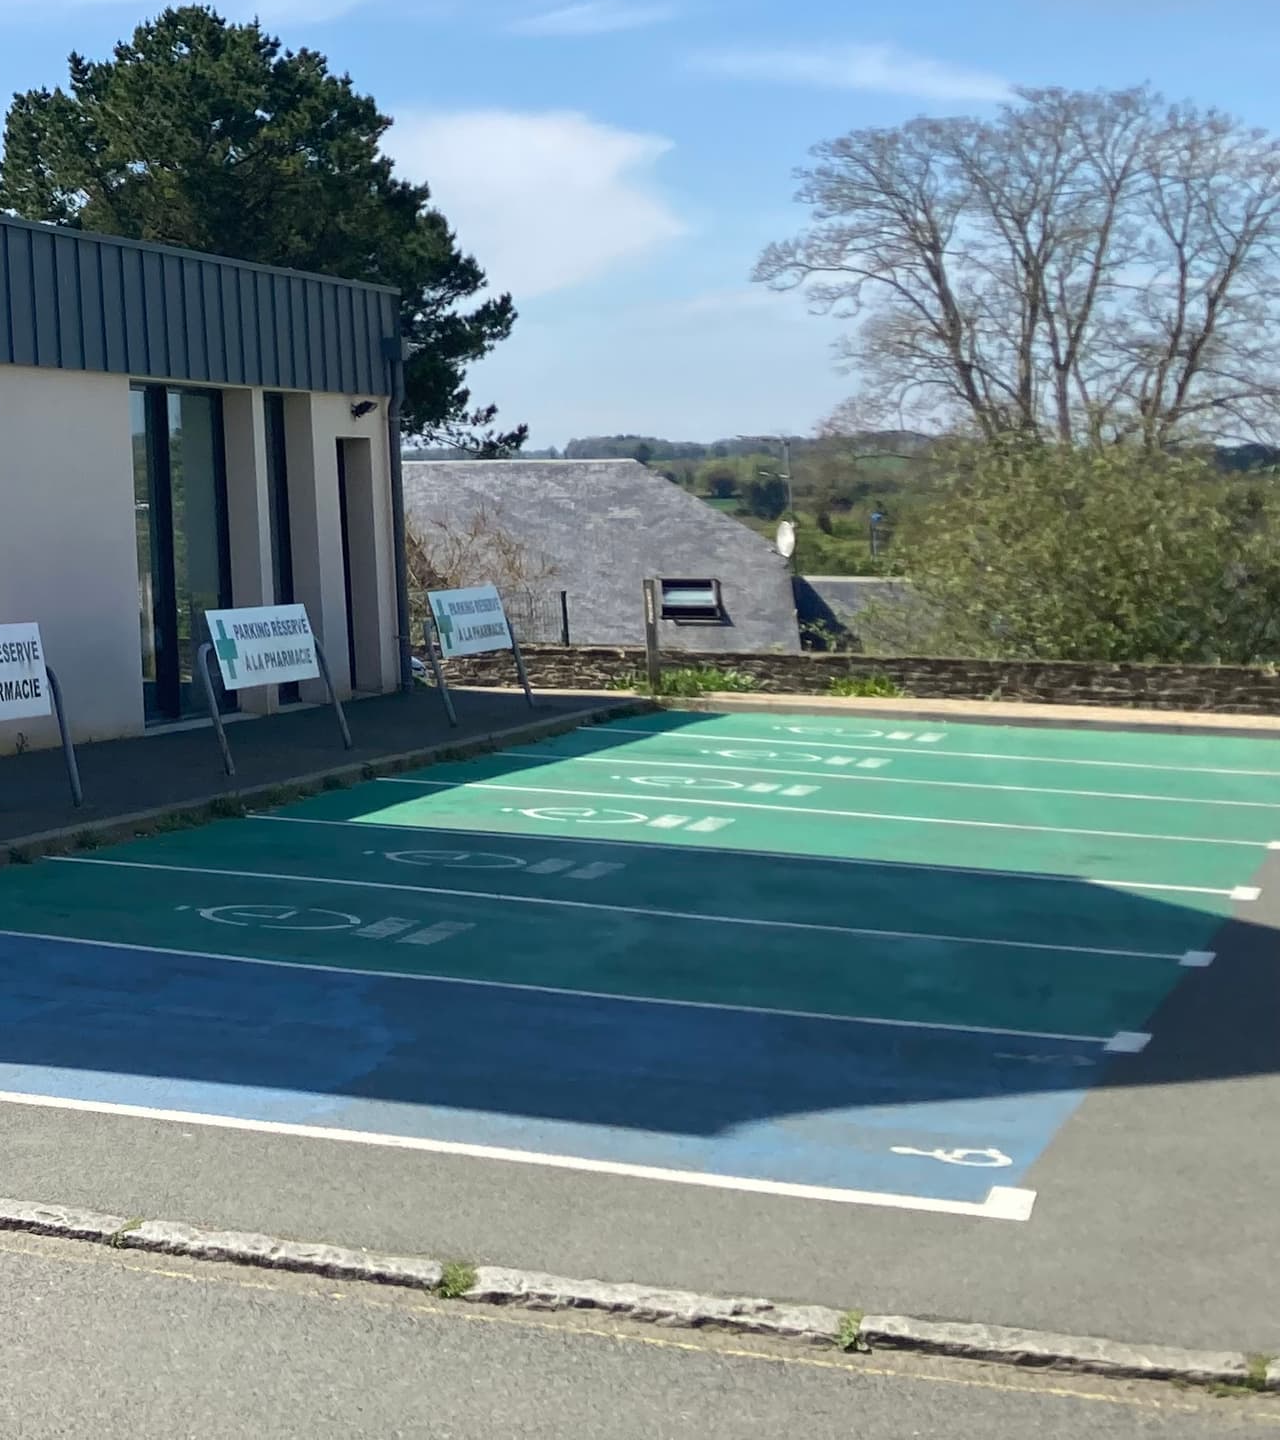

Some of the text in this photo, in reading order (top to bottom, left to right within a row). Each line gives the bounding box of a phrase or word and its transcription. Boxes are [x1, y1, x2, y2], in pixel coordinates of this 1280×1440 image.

[233, 614, 309, 640] PARKING RÉSERVÉ
[253, 653, 264, 671] LA
[264, 647, 312, 669] PHARMACIE
